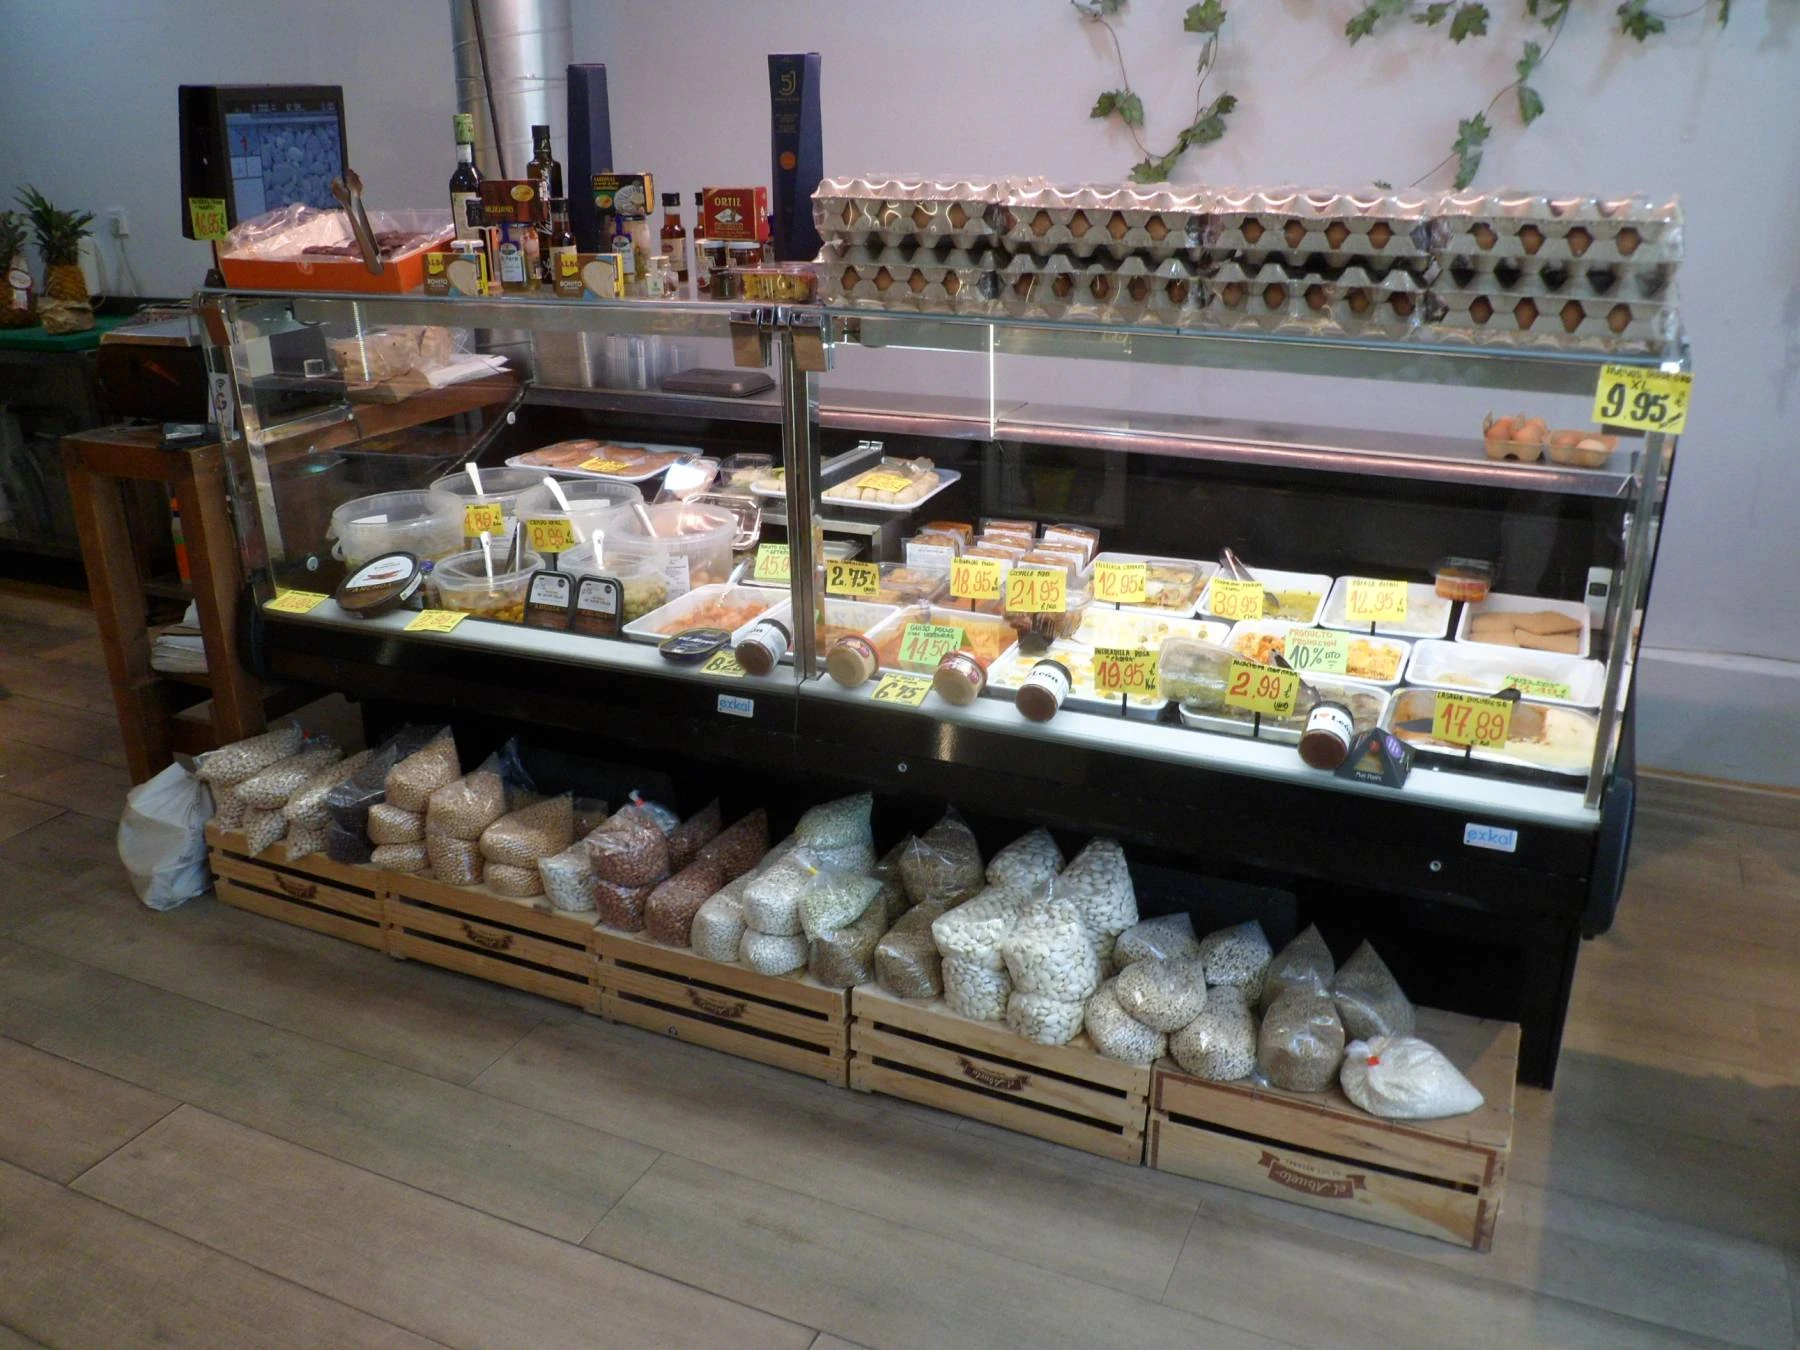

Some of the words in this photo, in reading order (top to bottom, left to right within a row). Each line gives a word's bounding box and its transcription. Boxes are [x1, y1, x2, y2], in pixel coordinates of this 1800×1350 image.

[714, 197, 742, 207] ORTIZ
[831, 565, 871, 588] 2.75
[953, 567, 992, 595] 18.95
[1009, 579, 1060, 607] 21.95
[1289, 645, 1324, 670] 10%
[1229, 671, 1281, 700] 2.99
[1440, 702, 1505, 741] 17.89
[1467, 828, 1514, 847] exkal
